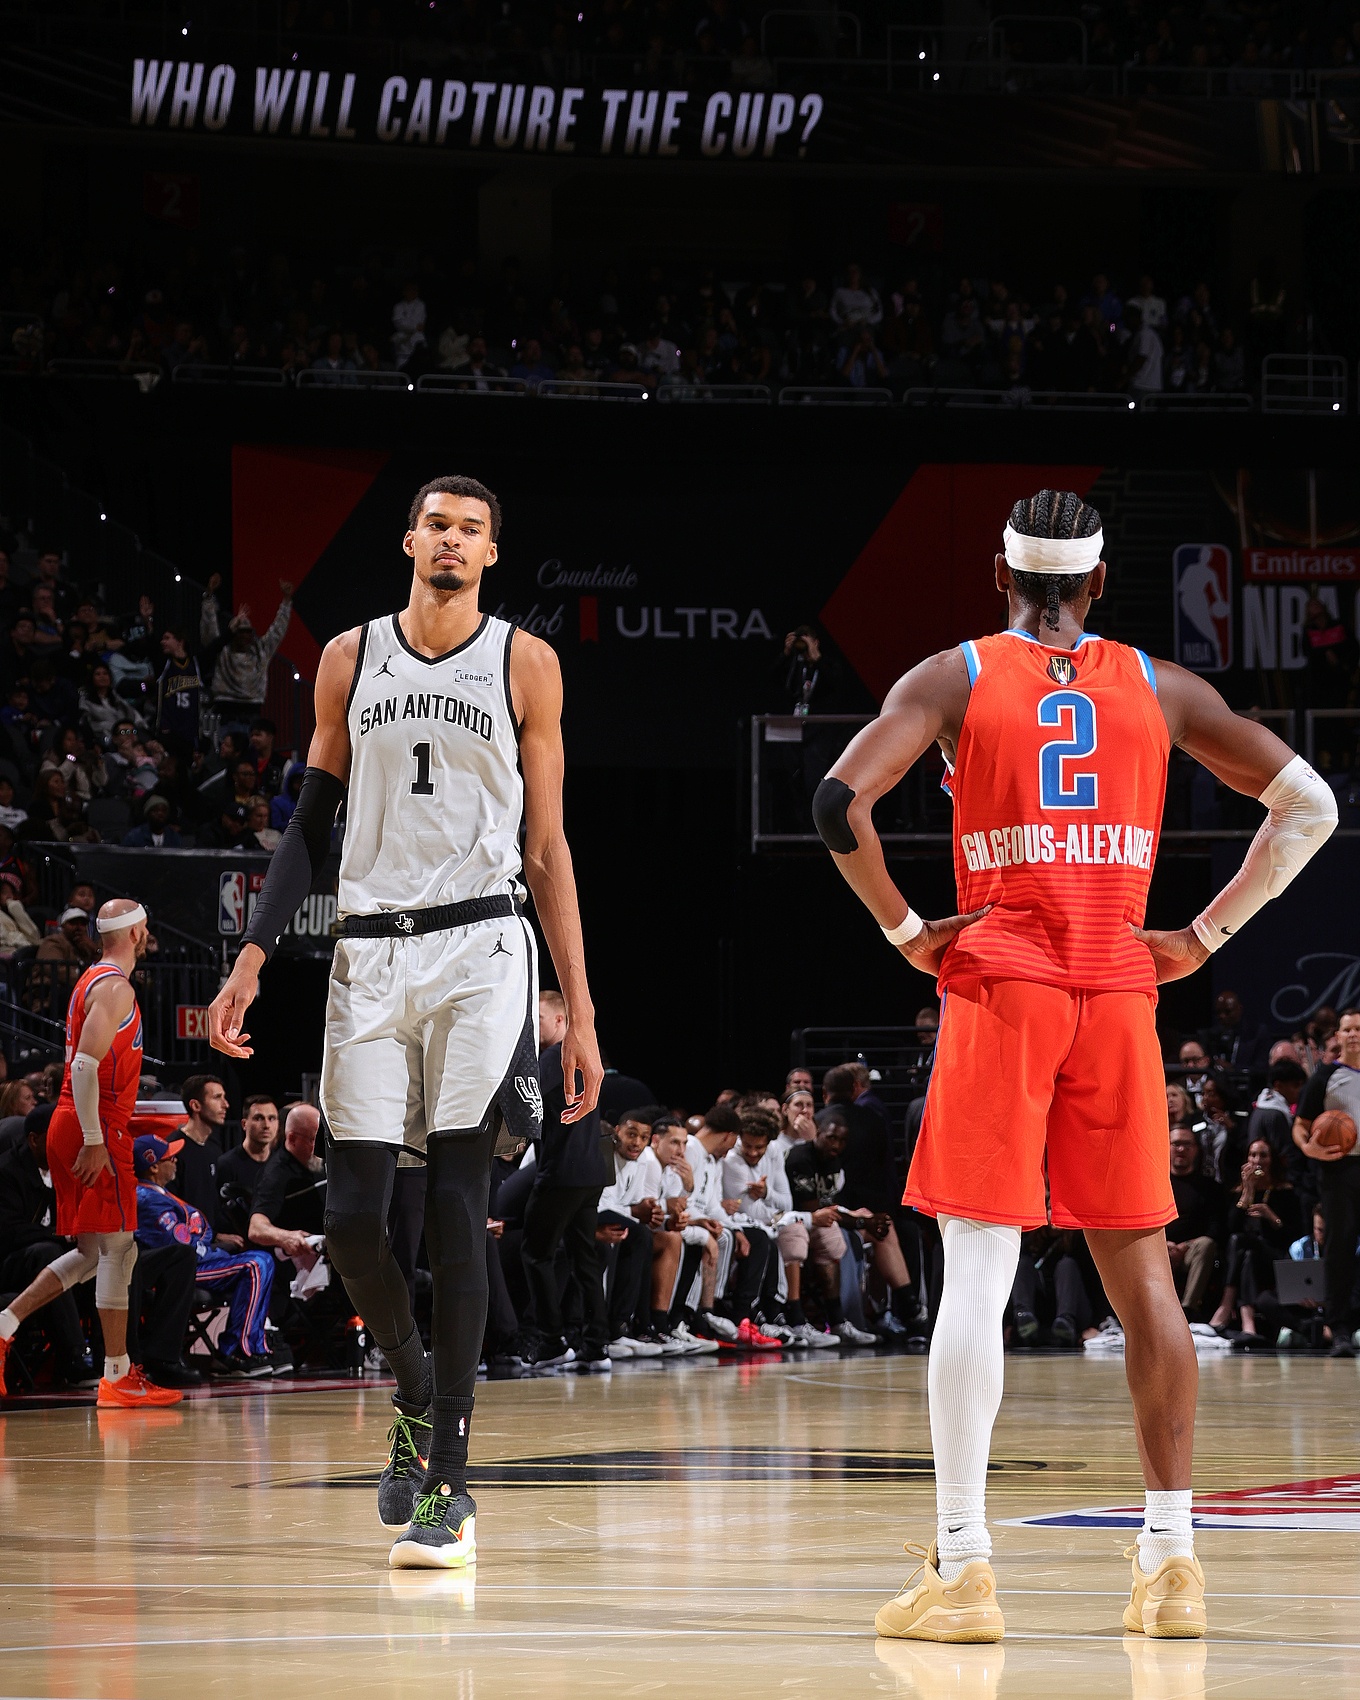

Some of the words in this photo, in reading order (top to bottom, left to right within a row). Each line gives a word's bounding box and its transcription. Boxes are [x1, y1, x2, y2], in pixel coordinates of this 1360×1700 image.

[130, 57, 237, 132] WHO
[252, 66, 358, 141] WILL
[375, 75, 586, 153] CAPTURE
[599, 87, 690, 158] THE
[700, 89, 825, 159] CUP?
[537, 558, 640, 590] Courtside
[1251, 550, 1357, 576] Emirates
[615, 604, 774, 641] ULTRA
[459, 673, 488, 683] LEDGER
[175, 691, 191, 709] 15
[359, 695, 399, 738] SAN
[401, 692, 494, 743] ANTONIO
[1037, 689, 1099, 810] 2
[409, 740, 436, 797] 1
[293, 893, 338, 937] CUP
[185, 1008, 209, 1037] EXI
